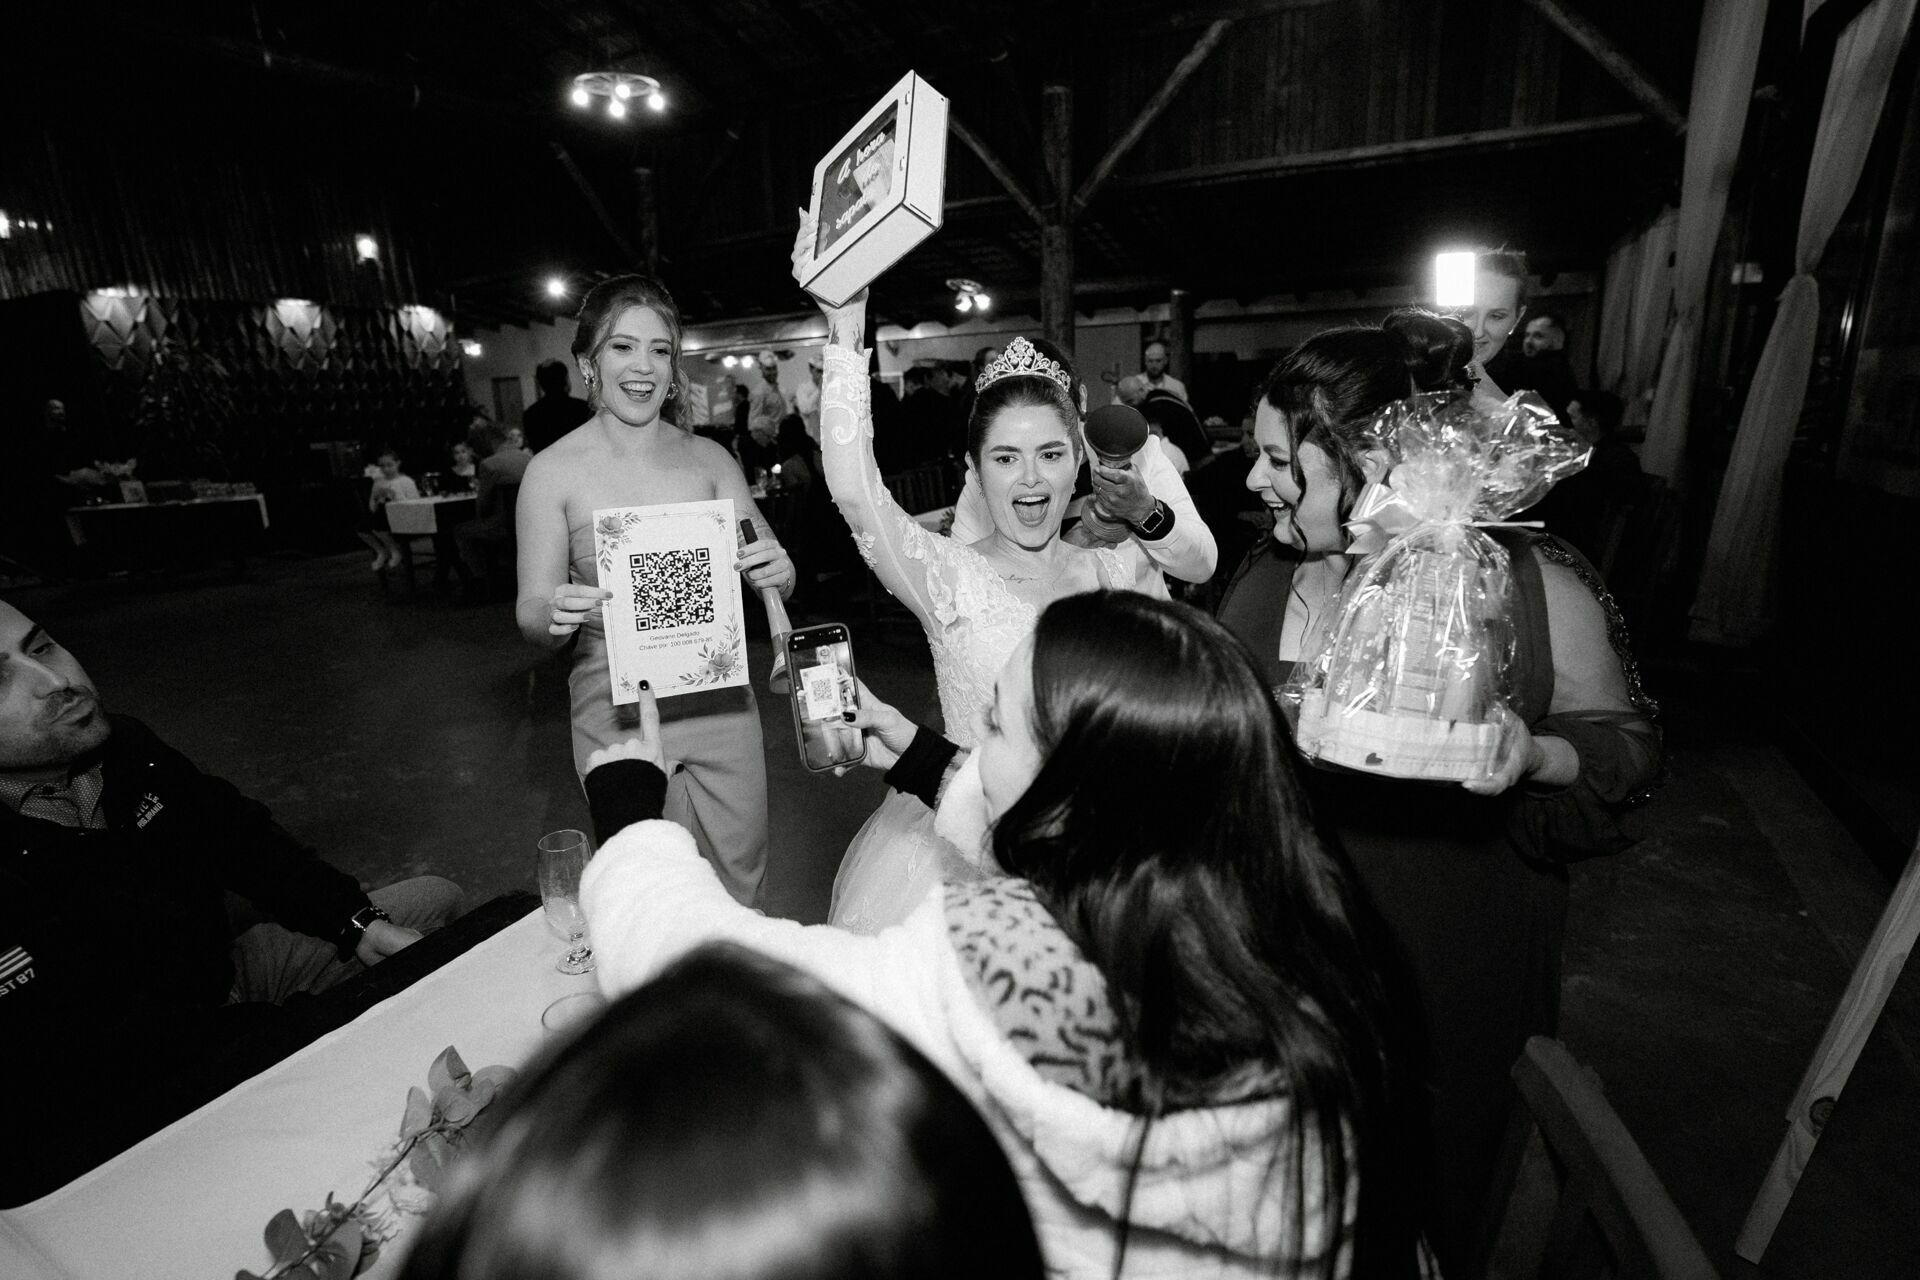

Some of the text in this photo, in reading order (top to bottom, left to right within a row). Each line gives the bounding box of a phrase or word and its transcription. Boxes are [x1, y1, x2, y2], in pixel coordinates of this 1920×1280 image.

[856, 131, 886, 167] hora
[676, 631, 700, 639] Delgado
[16, 967, 35, 984] 87
